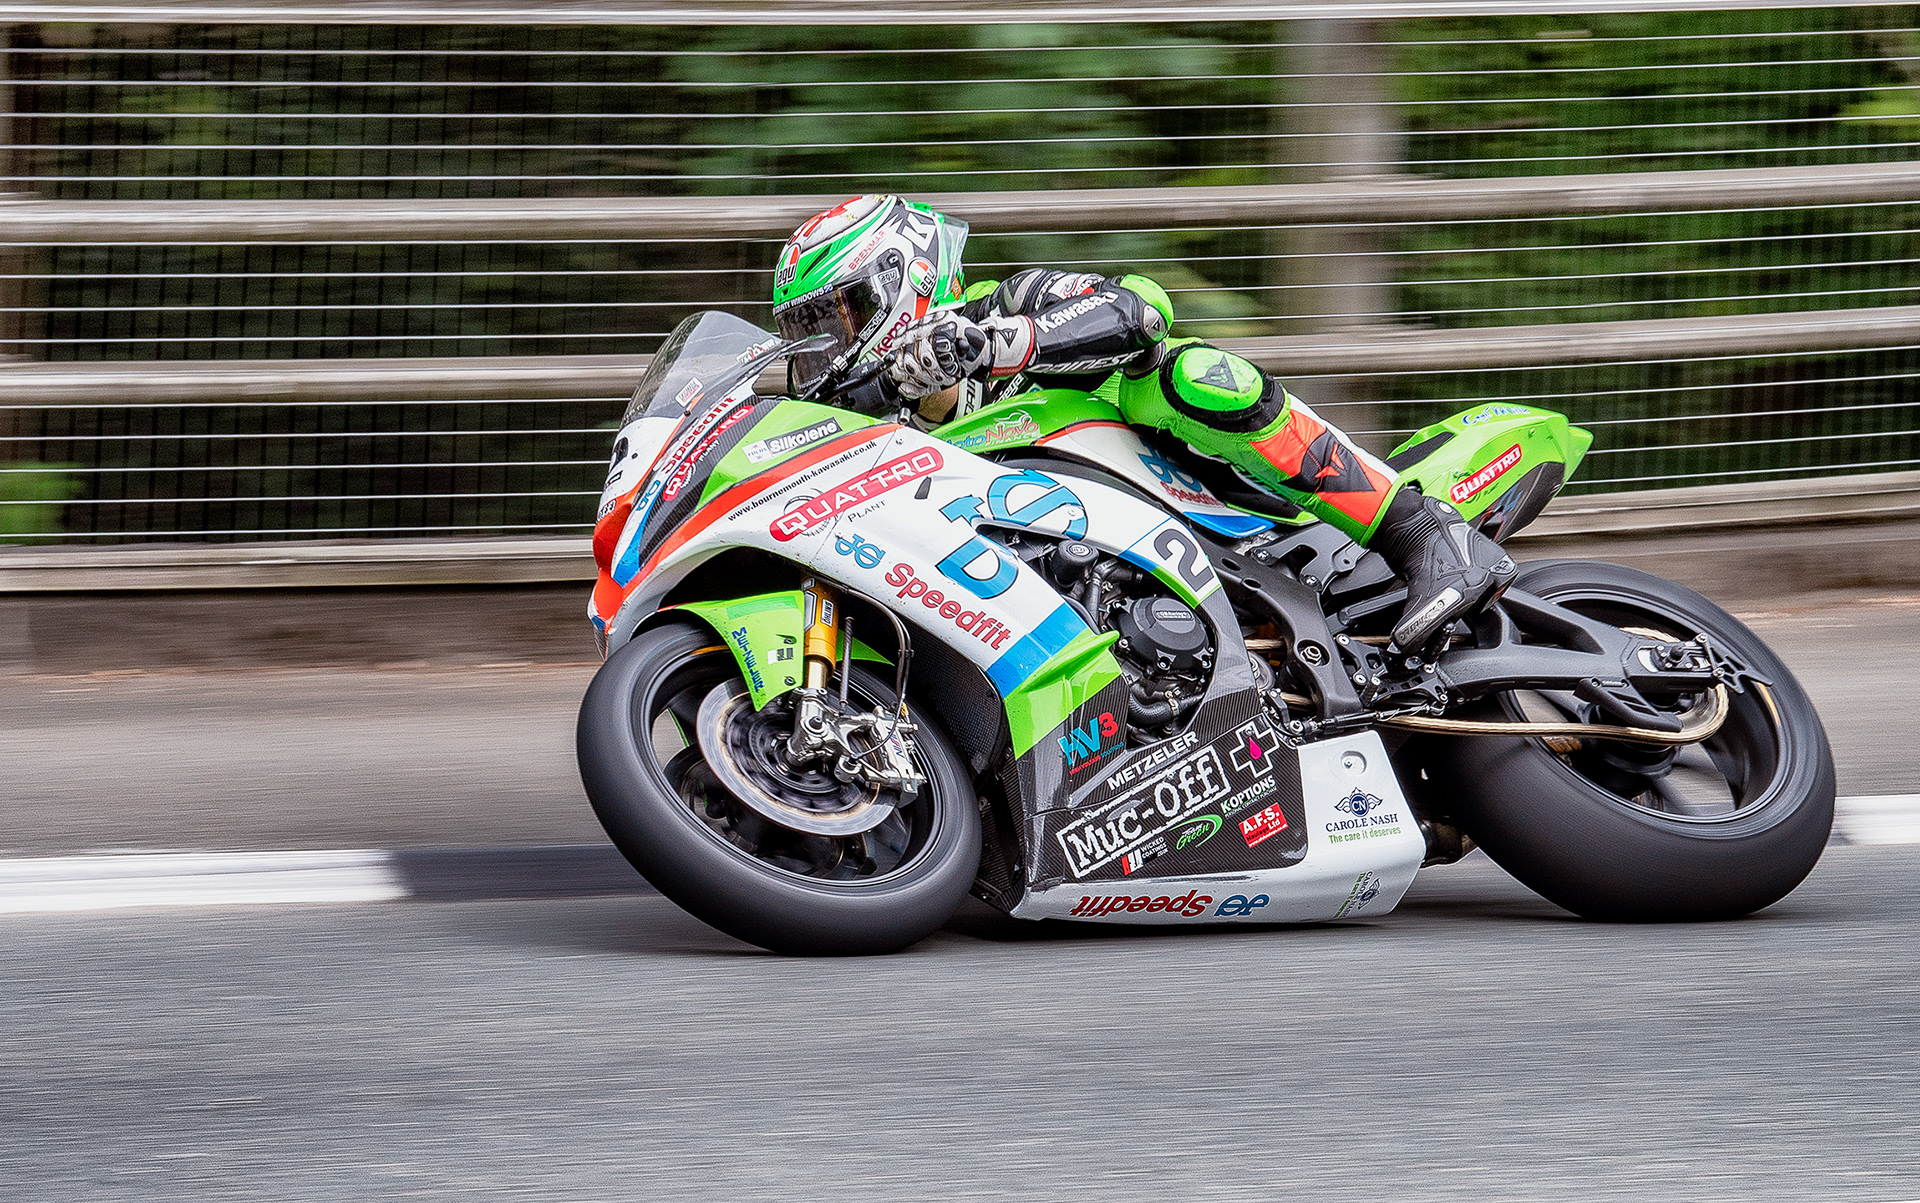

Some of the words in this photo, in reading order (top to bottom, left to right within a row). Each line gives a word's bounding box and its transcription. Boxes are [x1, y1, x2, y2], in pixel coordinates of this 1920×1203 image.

[665, 408, 749, 496] QUATTRO
[769, 422, 837, 453] Silkolene
[727, 440, 878, 522] www.bournemouth-kawasaki.co.uk
[776, 452, 937, 536] QUATTRO
[1452, 446, 1520, 500] QUATTRO
[847, 499, 887, 523] PLANT
[1153, 528, 1214, 593] 2
[885, 562, 1016, 651] Speedfit
[731, 626, 765, 693] METZELER
[1106, 731, 1200, 791] METZELER
[1243, 808, 1280, 834] A.F.S.
[1325, 817, 1369, 833] CAROLE
[1369, 813, 1399, 826] NASH
[1328, 834, 1344, 844] The
[1344, 832, 1361, 842] care
[1362, 830, 1369, 839] it
[1369, 826, 1402, 838] deserves
[1140, 837, 1165, 853] WICKED
[1141, 843, 1167, 859] COATINGS
[1069, 889, 1213, 918] Speedfit
